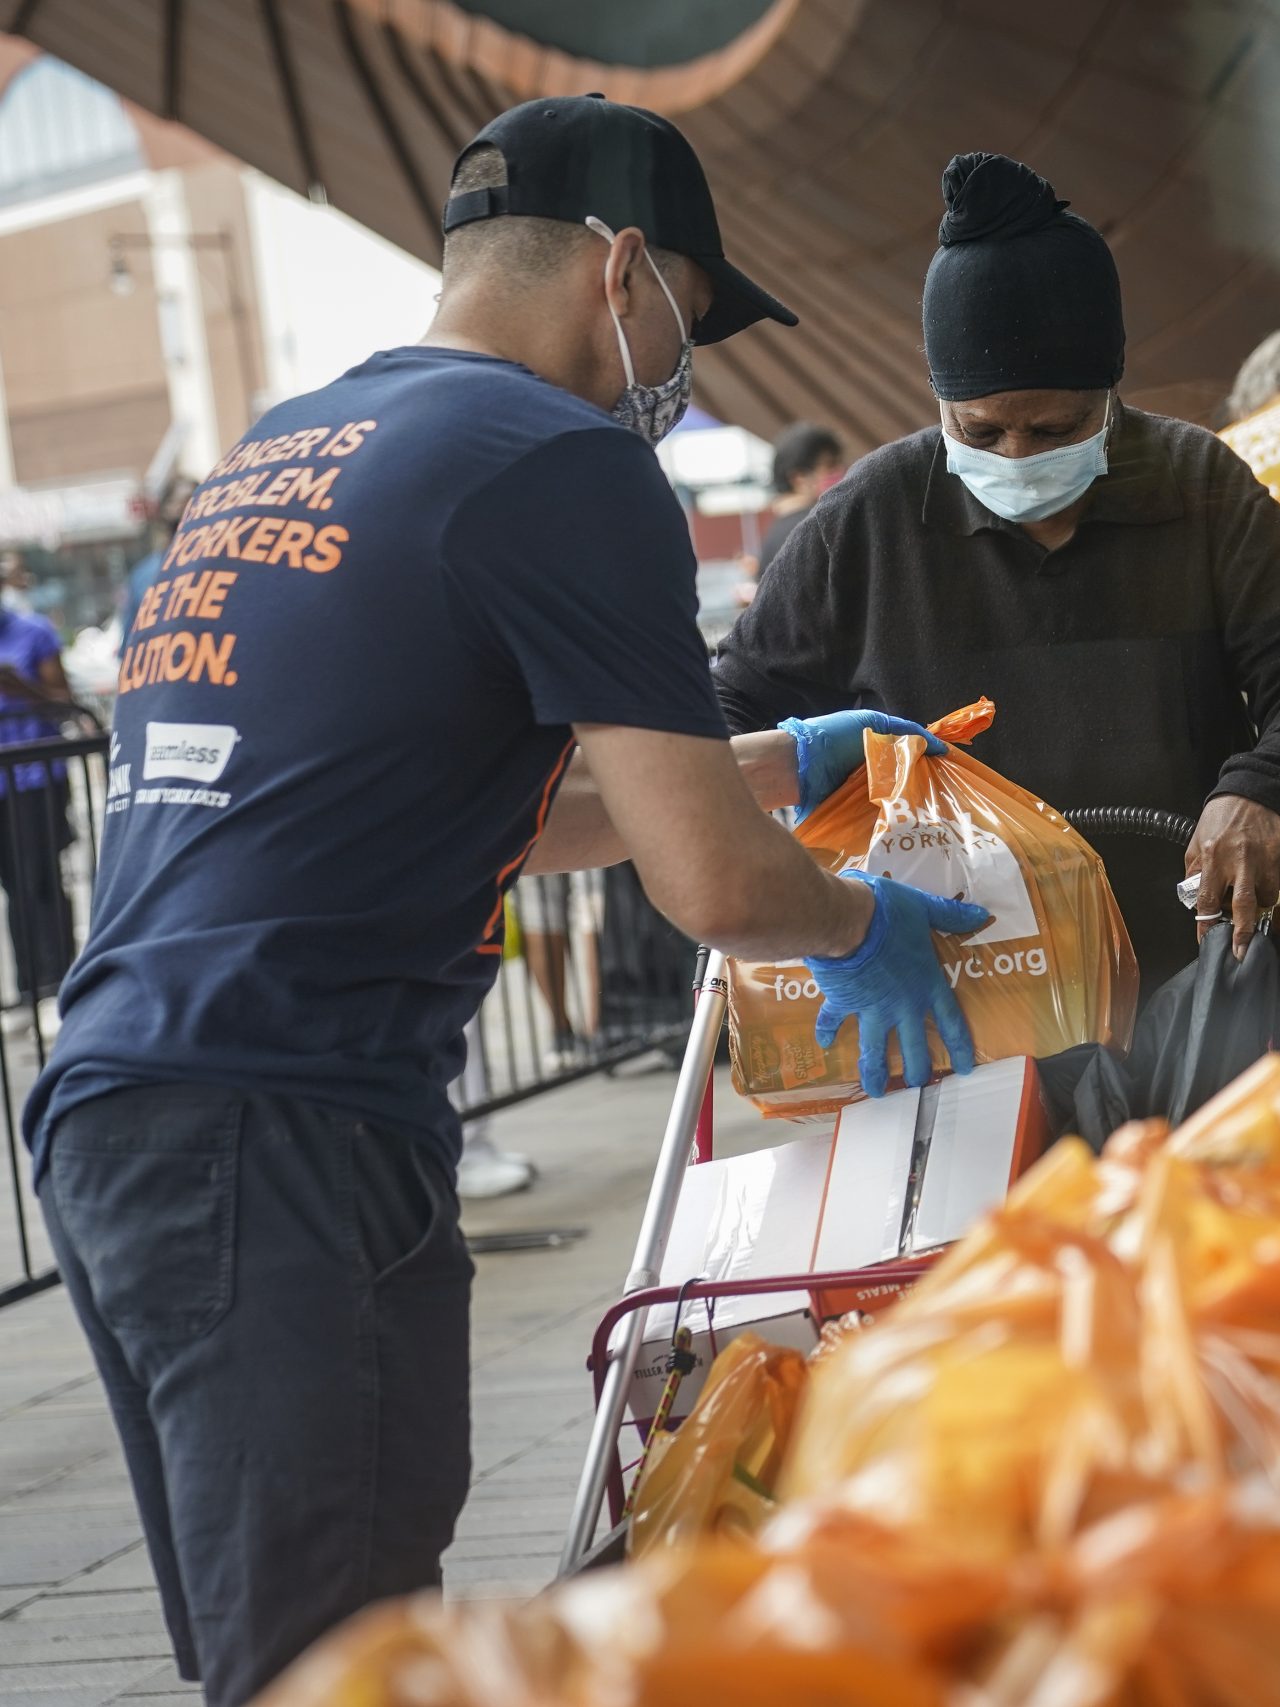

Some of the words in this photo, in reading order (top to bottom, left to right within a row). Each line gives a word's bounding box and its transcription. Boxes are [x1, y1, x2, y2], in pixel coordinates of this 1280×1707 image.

[318, 420, 377, 457] IS
[192, 467, 342, 520] PROBLEM.
[162, 515, 350, 574] YORKERS
[131, 580, 170, 634] RE
[163, 570, 239, 621] THE
[118, 631, 239, 694] LUTION.
[881, 831, 952, 853] YORK
[634, 1365, 664, 1380] TILLER
